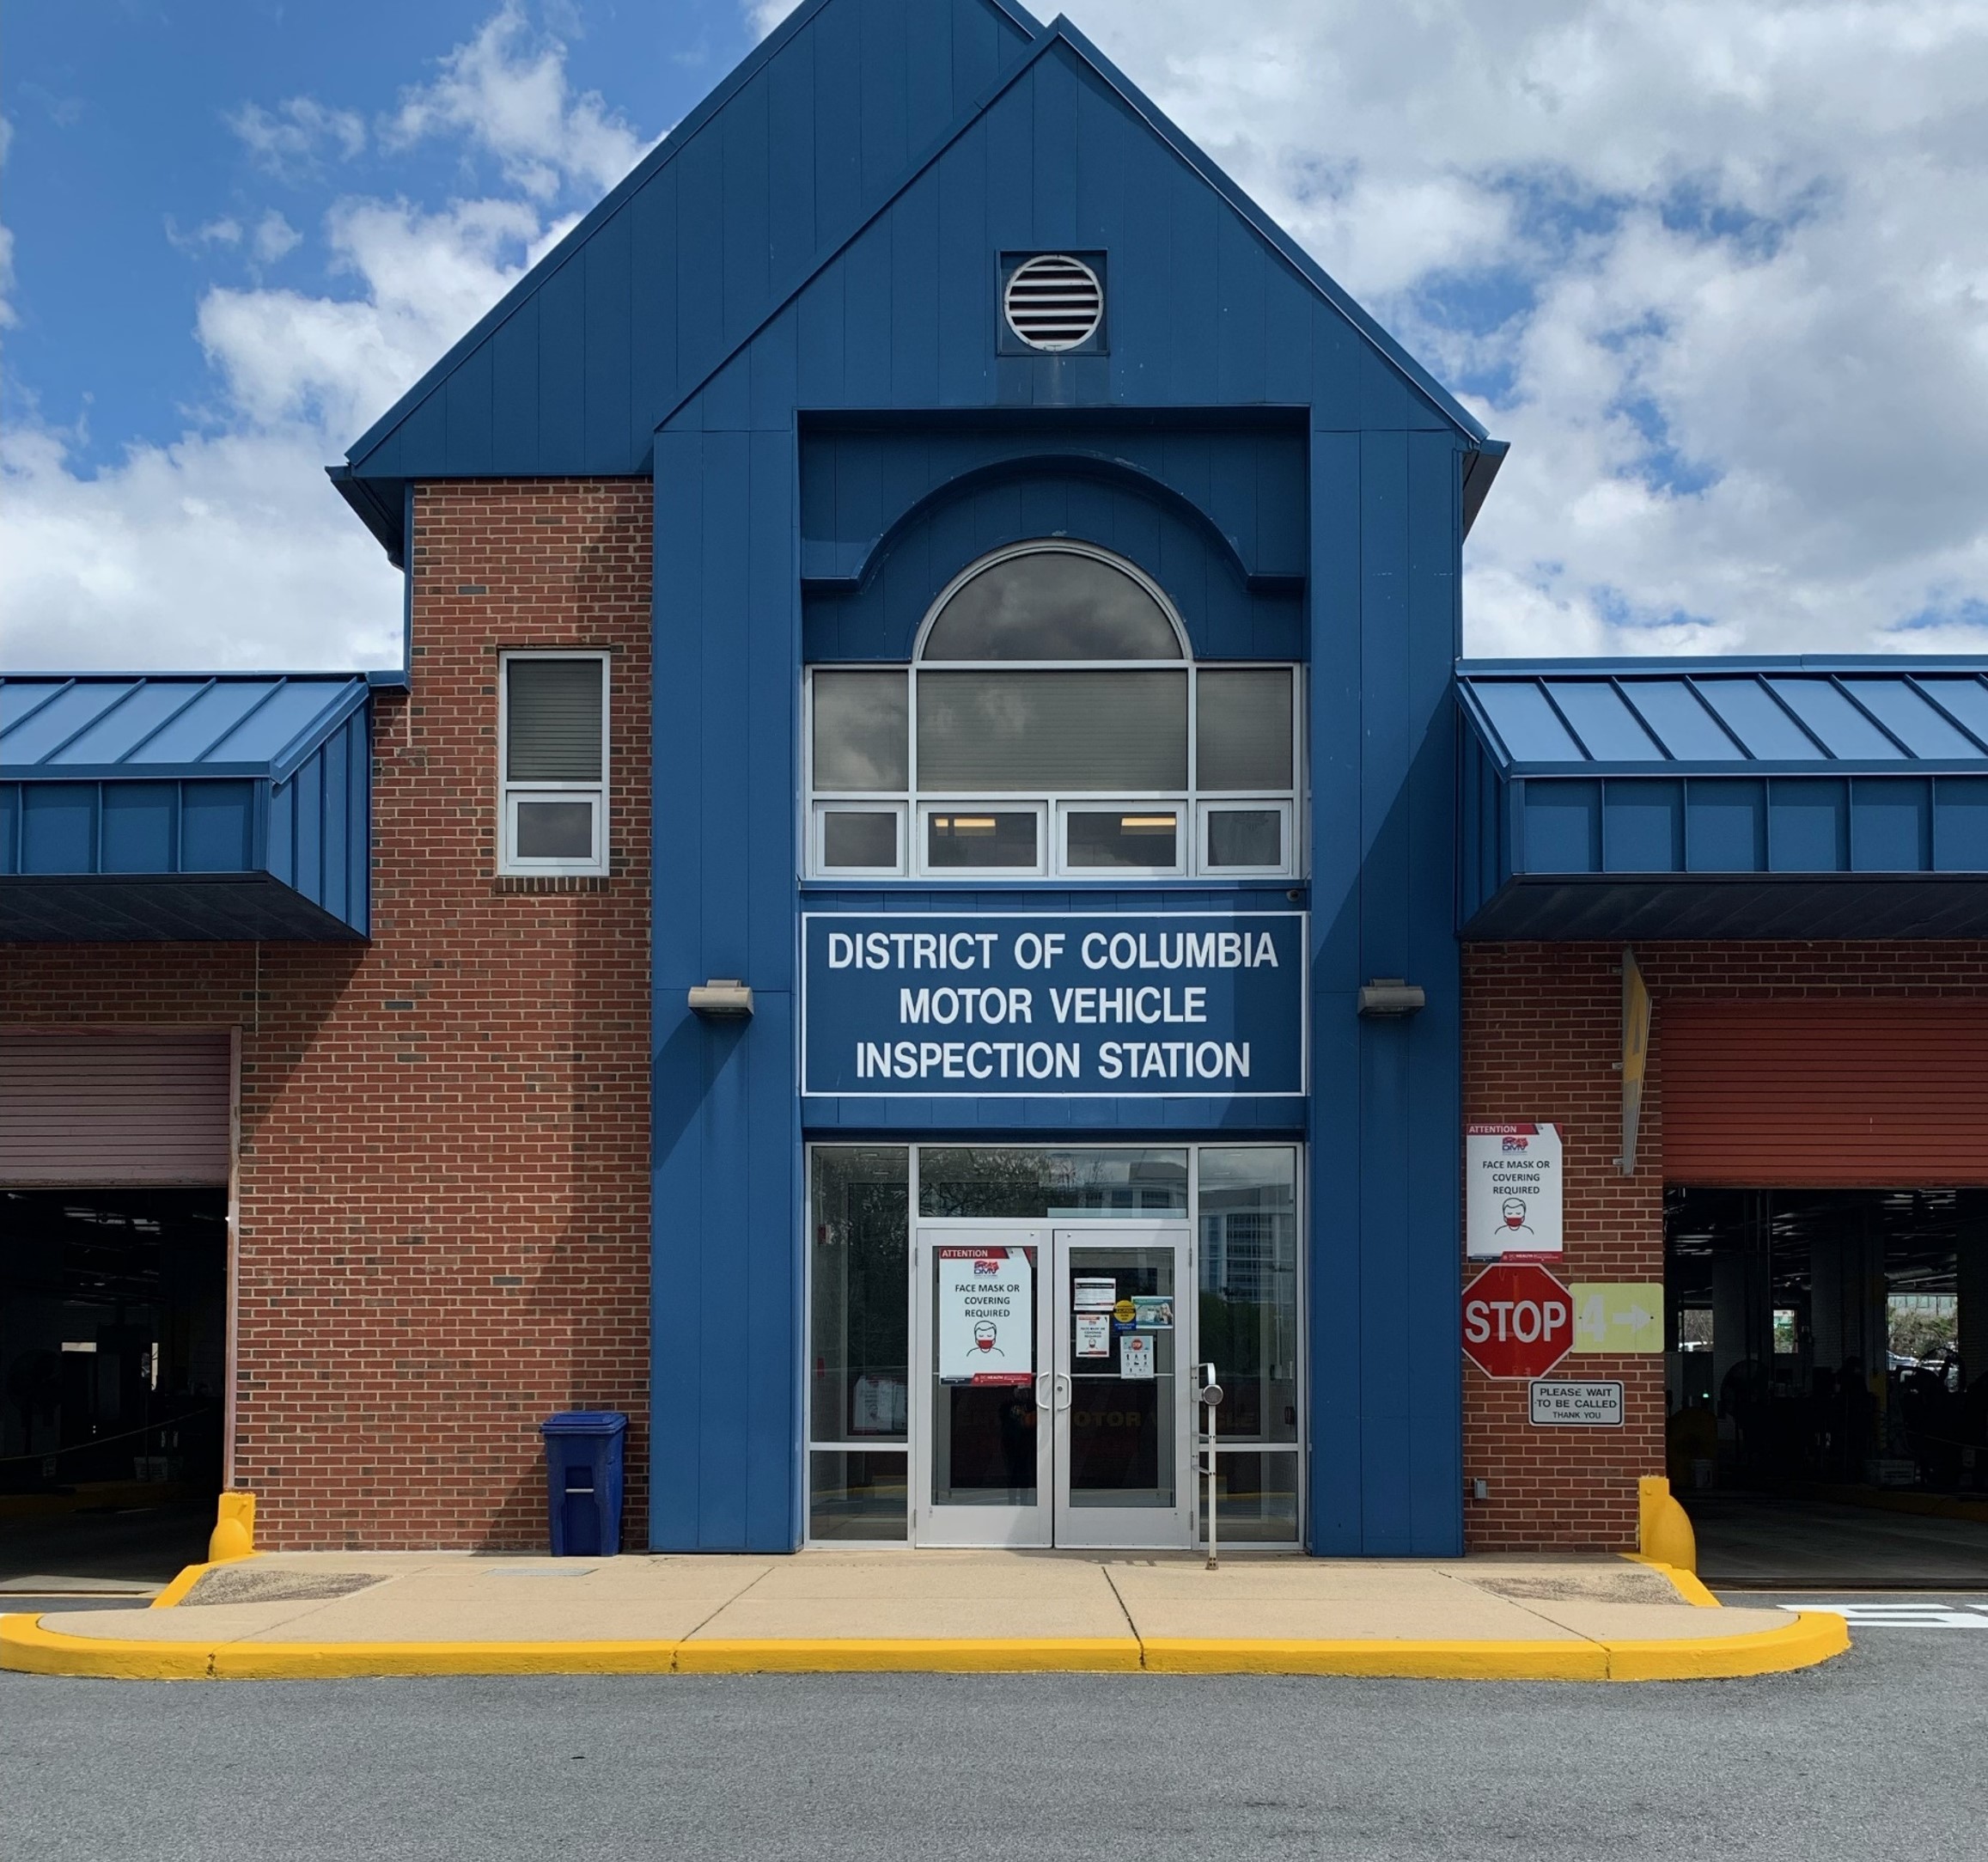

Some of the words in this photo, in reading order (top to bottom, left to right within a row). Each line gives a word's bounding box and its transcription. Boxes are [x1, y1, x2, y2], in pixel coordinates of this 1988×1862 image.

[828, 933, 998, 969] DISTRICT
[1014, 933, 1065, 969] OF
[1082, 932, 1278, 969] COLUMBIA
[900, 987, 1033, 1024] MOTOR
[1049, 987, 1207, 1023] VEHICLE
[857, 1042, 1080, 1079] INSPECTION
[1098, 1042, 1250, 1078] STATION
[1468, 1125, 1517, 1133] ATTENTION
[1482, 1160, 1504, 1169] FACE
[1507, 1160, 1534, 1169] MASK
[1536, 1160, 1550, 1169] OR
[1492, 1173, 1540, 1182] COVERING
[1493, 1186, 1540, 1195] REQUIRED
[954, 1284, 976, 1292] FACE
[979, 1284, 1005, 1292] MASK
[1006, 1284, 1020, 1292] OR
[964, 1297, 1010, 1305] COVERING
[965, 1309, 1010, 1318] REQUIRED
[1581, 1294, 1607, 1342] 4
[1465, 1300, 1566, 1343] STOP
[1540, 1388, 1582, 1397] PLEASE
[1585, 1388, 1613, 1397] WAIT
[1536, 1399, 1552, 1408] TO
[1555, 1399, 1570, 1408] BE
[1574, 1399, 1618, 1409] CALLED
[1552, 1411, 1581, 1419] THANK
[1583, 1411, 1601, 1419] YOU
